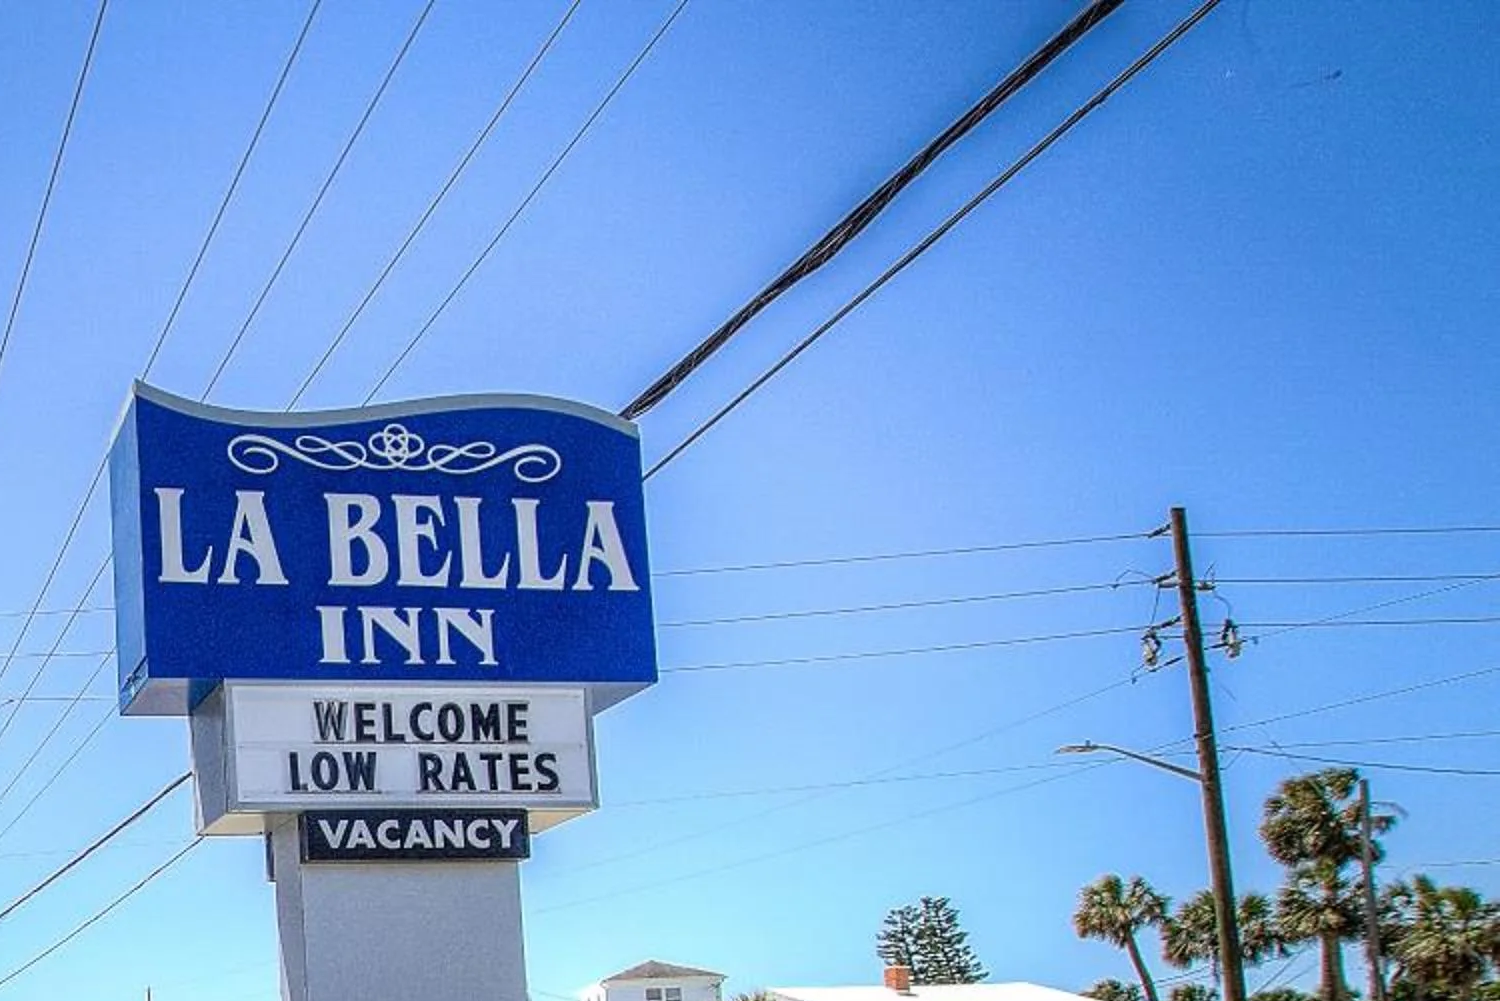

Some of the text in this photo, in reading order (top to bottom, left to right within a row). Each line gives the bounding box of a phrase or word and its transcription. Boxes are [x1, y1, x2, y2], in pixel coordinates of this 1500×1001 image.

[154, 487, 640, 591] LA BELLA
[315, 605, 499, 665] INN
[313, 700, 529, 741] WELCOME
[288, 751, 561, 791] LOW RATES
[318, 818, 520, 849] VACANCY
